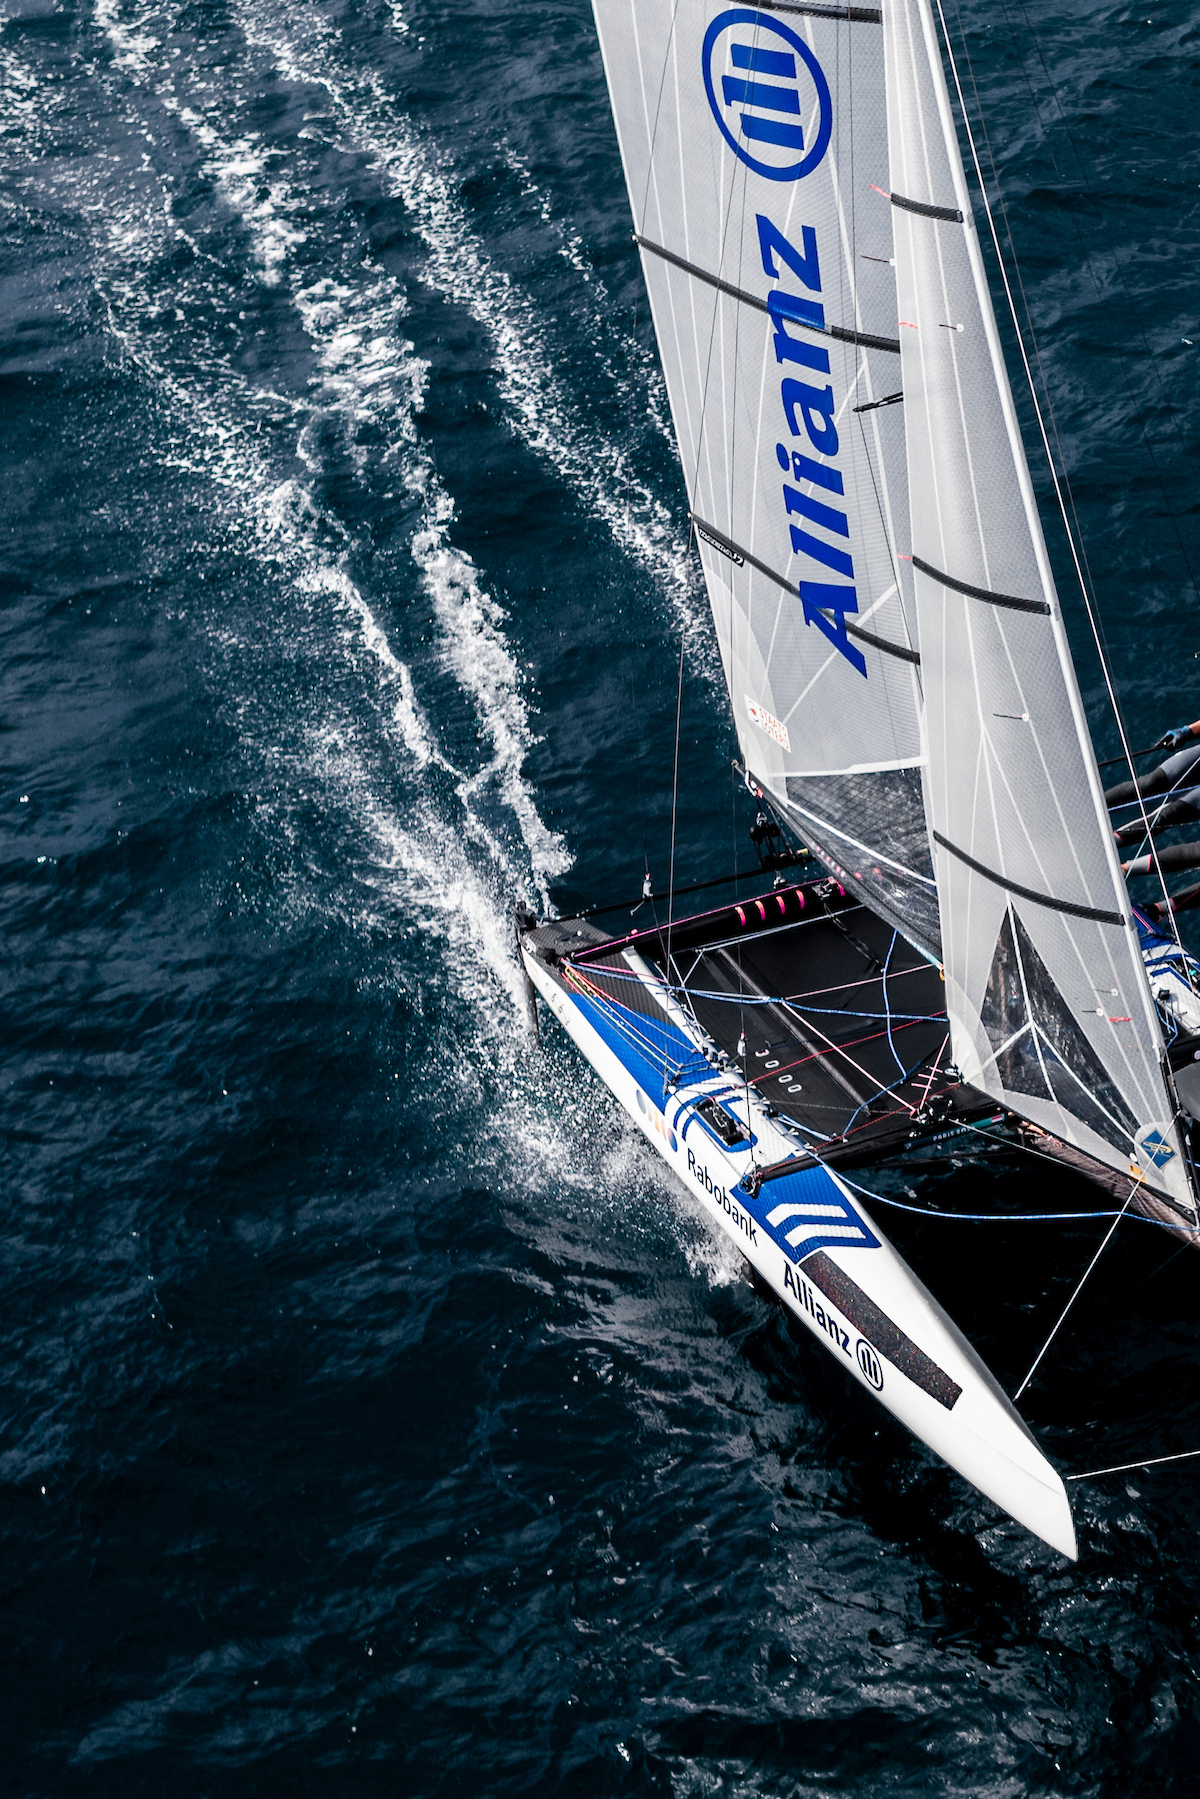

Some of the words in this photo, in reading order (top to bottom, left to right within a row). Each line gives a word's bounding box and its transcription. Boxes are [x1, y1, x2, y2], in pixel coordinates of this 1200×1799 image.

[756, 213, 867, 679] Allianz
[687, 1147, 758, 1247] Rabobank
[783, 1260, 852, 1358] Allianz
